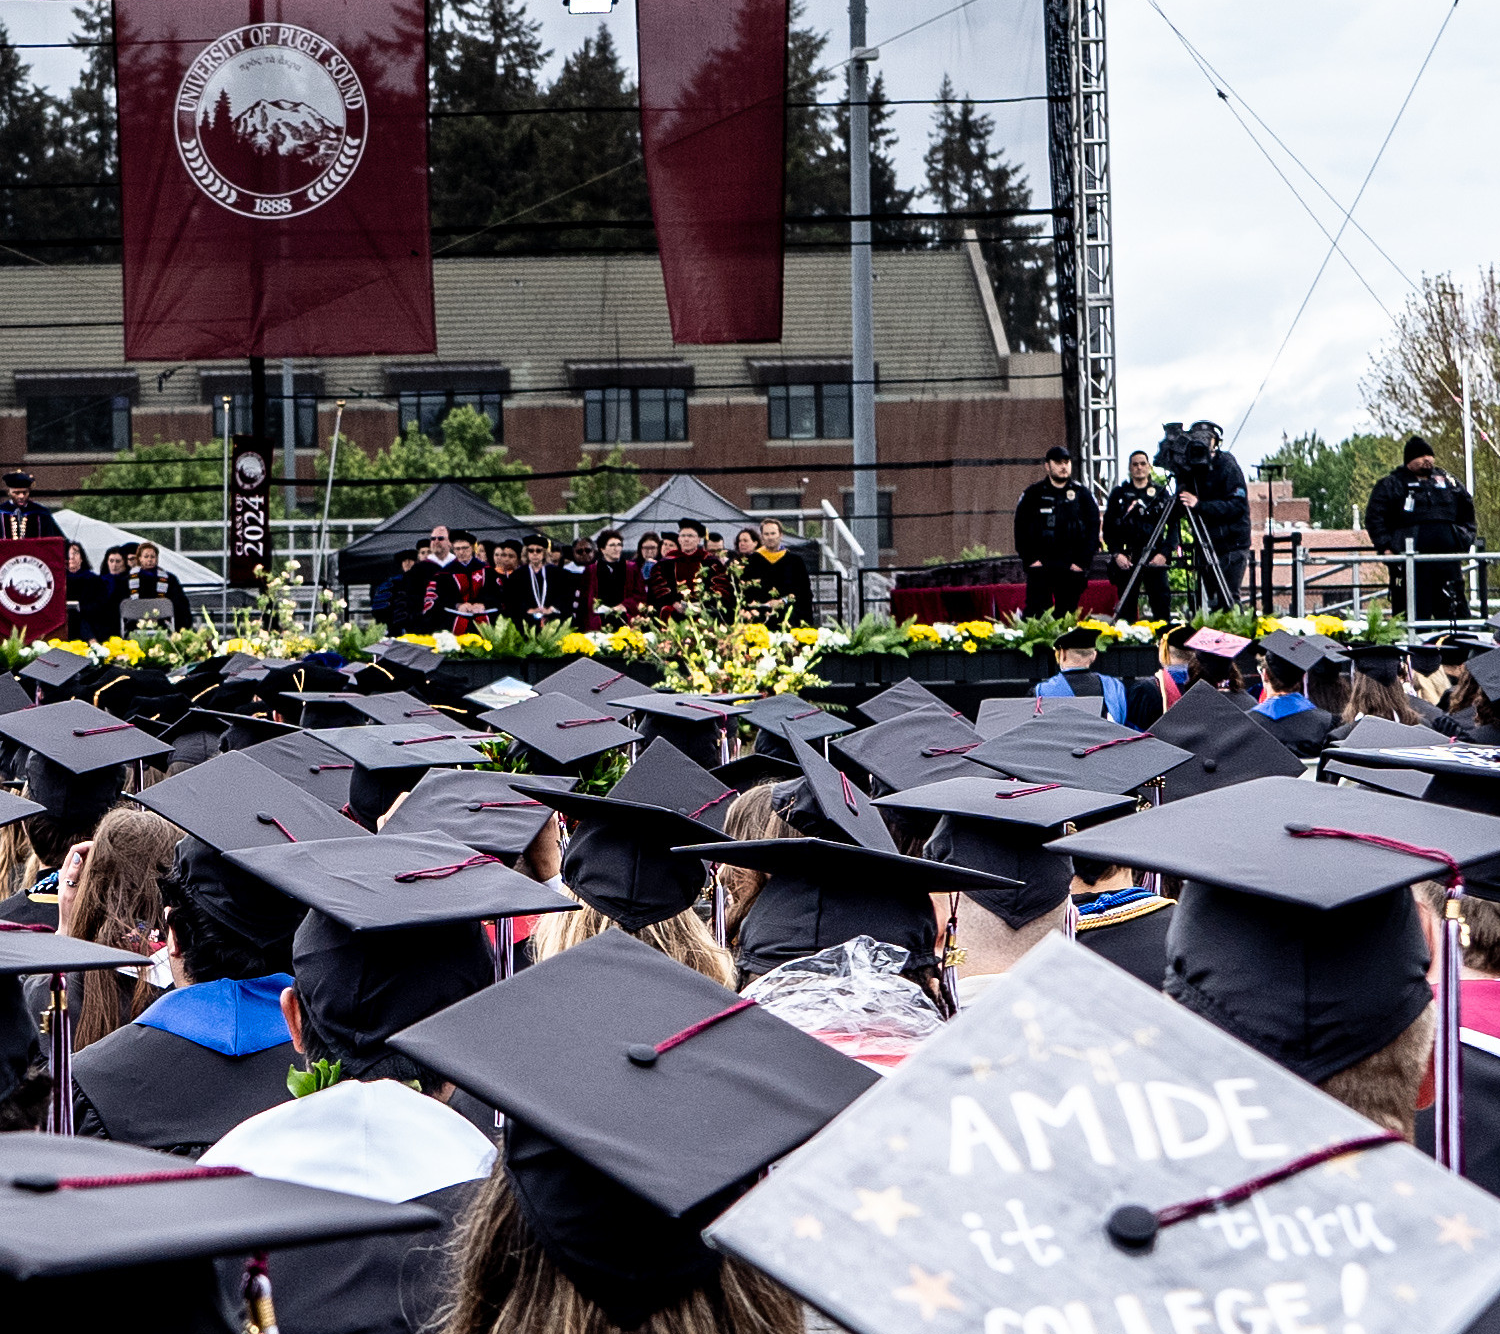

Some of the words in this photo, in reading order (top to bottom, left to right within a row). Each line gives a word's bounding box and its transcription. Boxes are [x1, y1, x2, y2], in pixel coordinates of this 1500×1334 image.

[178, 31, 246, 112] UNIVERSITY
[250, 26, 271, 46] OF
[278, 26, 330, 60] PUGET
[324, 55, 363, 110] SOUND
[253, 198, 292, 214] 1888
[235, 494, 244, 512] OF
[243, 494, 265, 557] 2024
[235, 515, 244, 556] CLASS
[949, 1077, 1289, 1175] AMIDE
[962, 1198, 1064, 1274] it
[1200, 1186, 1396, 1261] thru
